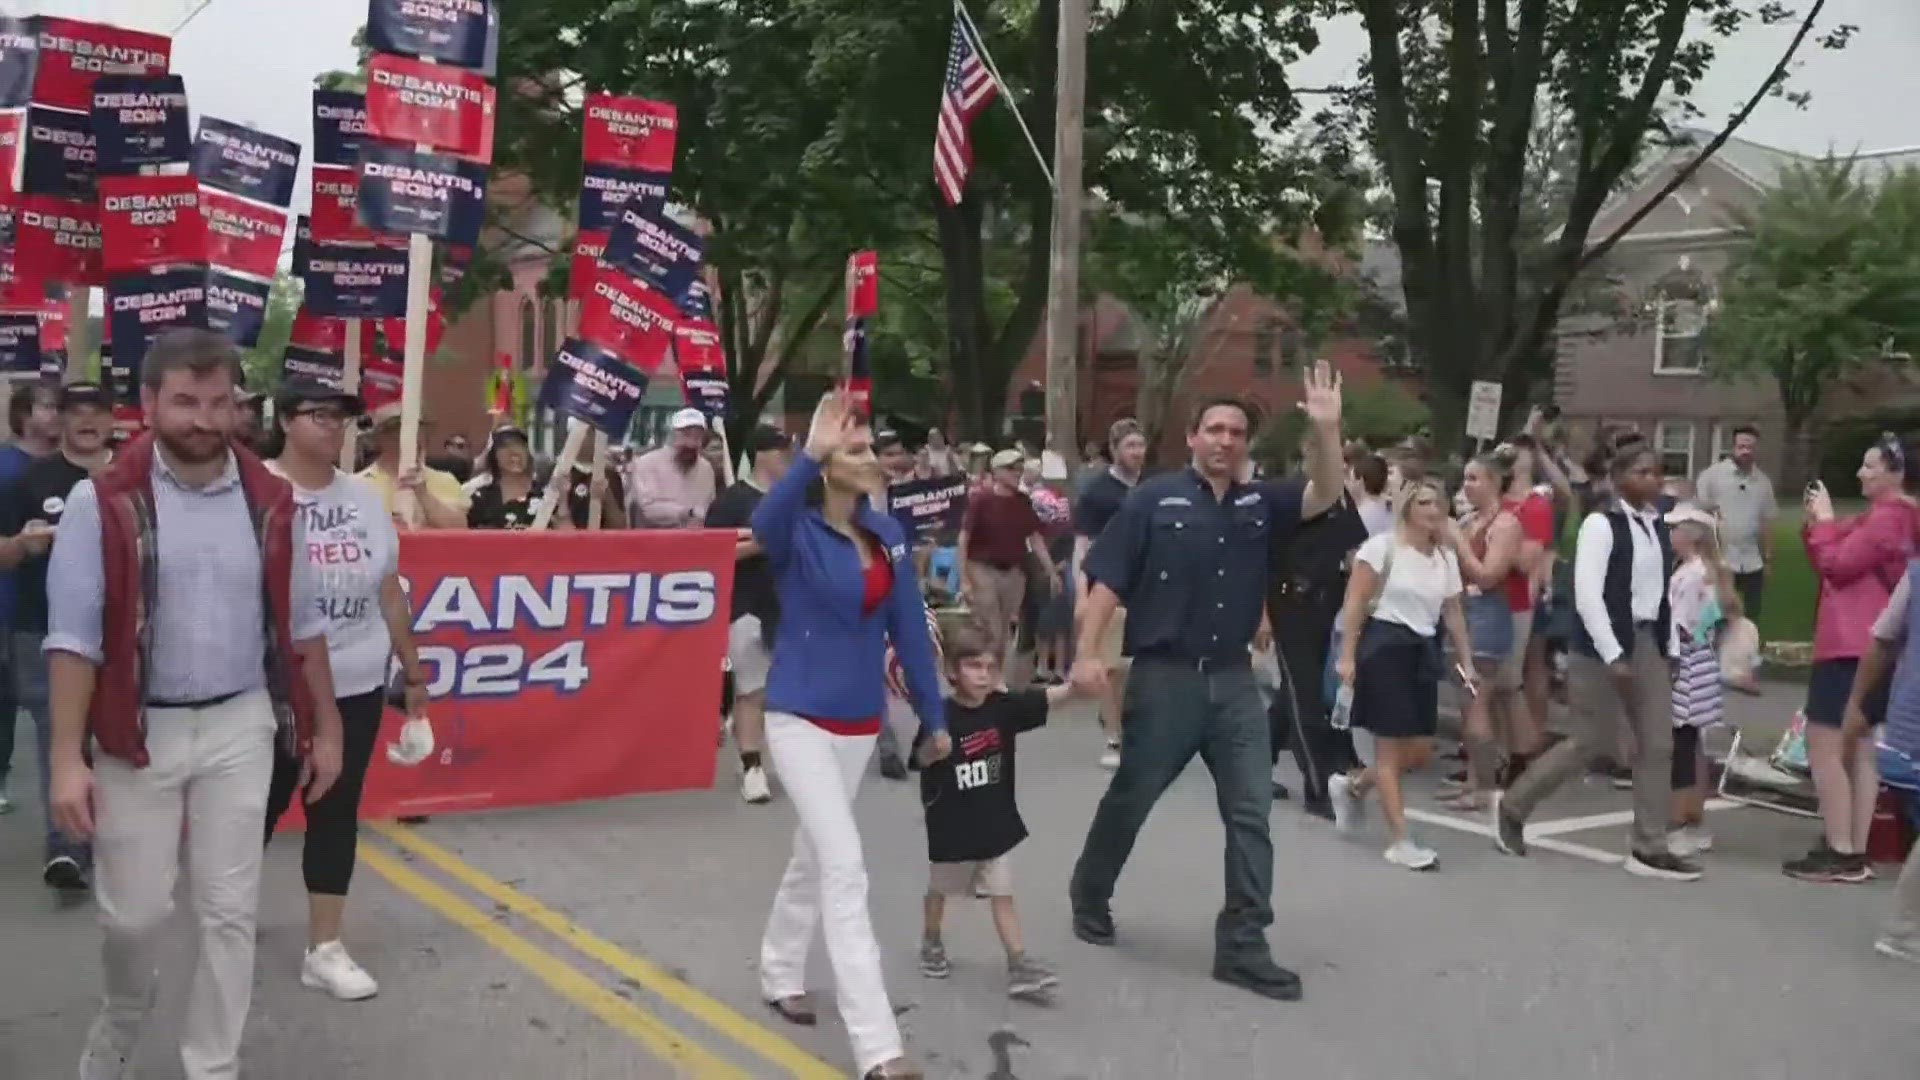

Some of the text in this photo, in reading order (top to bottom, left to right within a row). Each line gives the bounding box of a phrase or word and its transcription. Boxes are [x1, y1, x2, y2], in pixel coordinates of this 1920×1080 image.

[40, 31, 167, 68] DESANTIS
[373, 69, 481, 104] DESANTIS
[400, 90, 457, 110] 2024
[119, 110, 167, 124] 2024
[590, 107, 675, 129] DESANTIS
[608, 121, 650, 137] 2024
[200, 128, 297, 166] DESANTIS
[365, 162, 472, 192] DESANTIS
[391, 180, 448, 201] 2024
[584, 175, 665, 196] DESANTIS
[105, 193, 197, 211] DESANTIS
[130, 209, 176, 225] 2024
[624, 210, 701, 262] DESANTIS
[637, 232, 677, 262] 2024
[309, 260, 405, 276] DESANTIS
[114, 288, 203, 311] DESANTIS
[139, 304, 186, 323] 2024
[594, 282, 674, 331] DESANTIS
[609, 303, 651, 332] 2024
[559, 350, 641, 399] DESANTIS
[573, 372, 618, 401] 2024
[398, 570, 716, 632] ANTIS
[390, 640, 589, 697] 024
